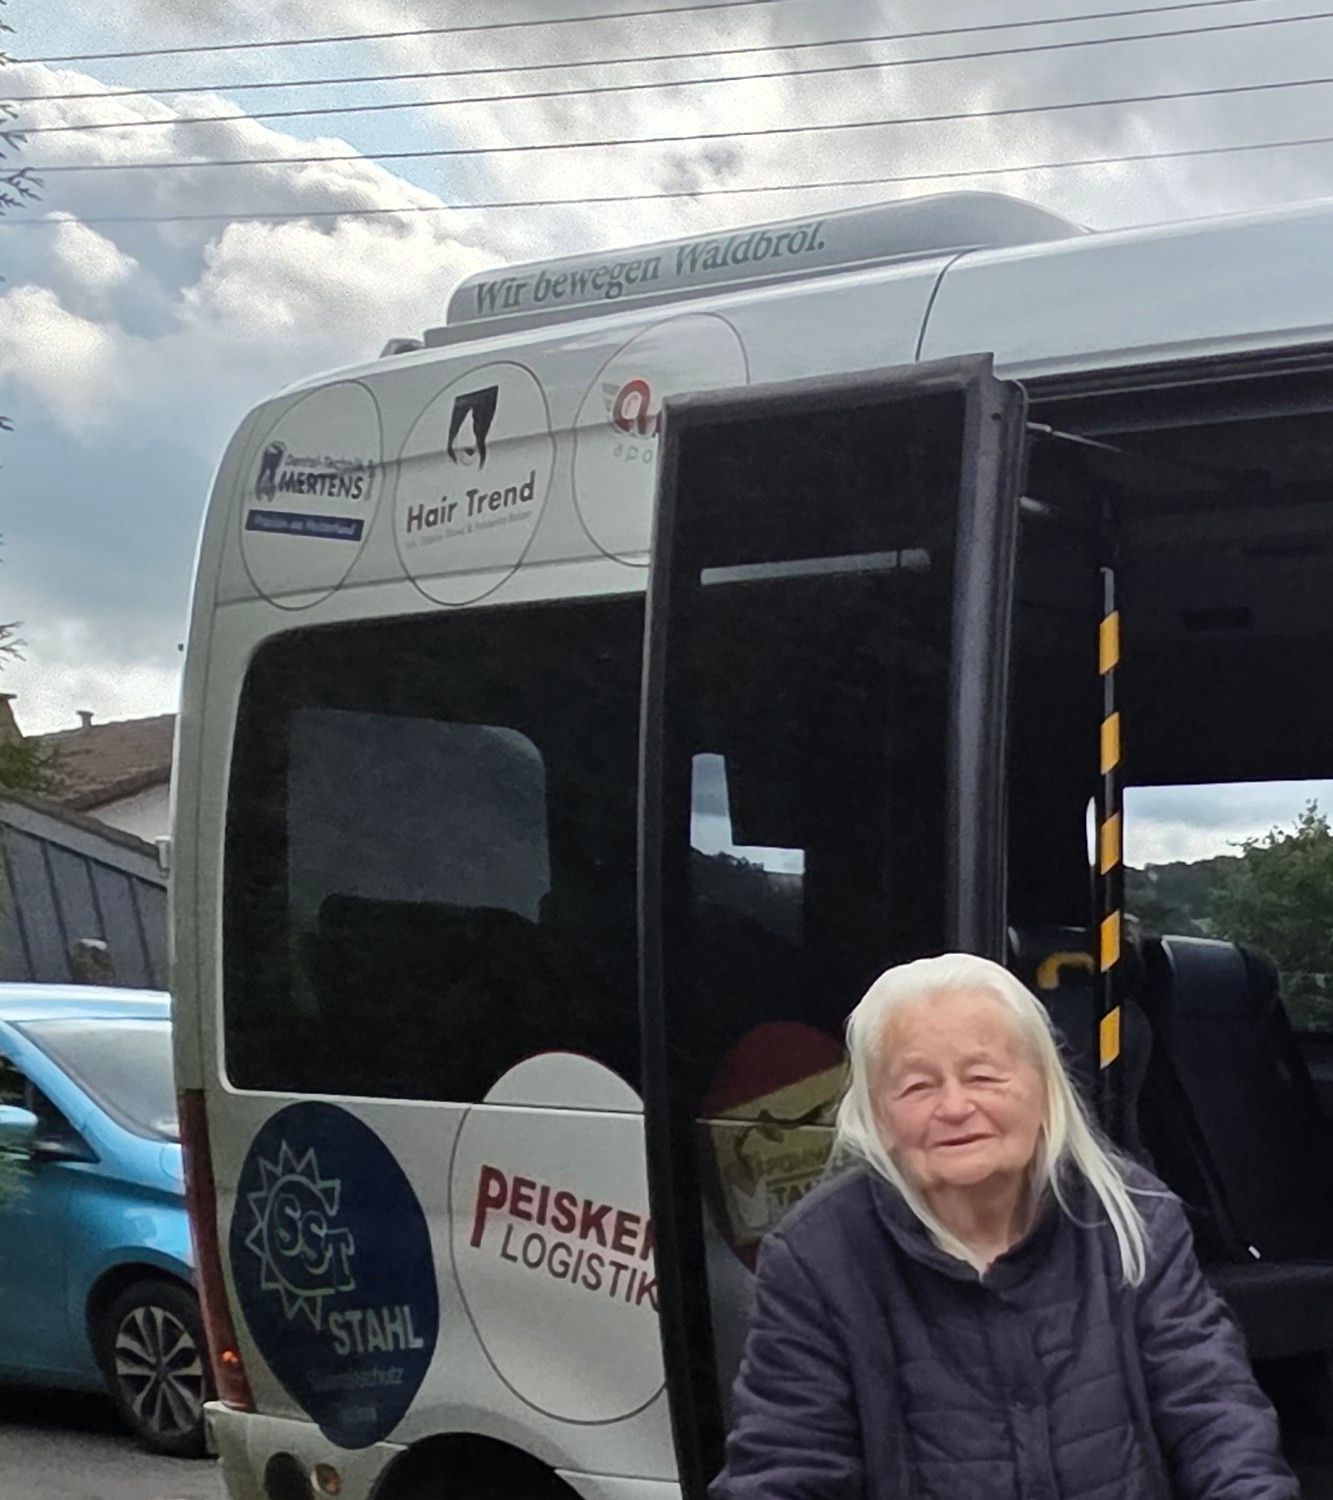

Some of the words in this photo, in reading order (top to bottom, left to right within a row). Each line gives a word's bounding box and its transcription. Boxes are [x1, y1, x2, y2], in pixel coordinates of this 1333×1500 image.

[476, 277, 526, 314] Wir
[533, 257, 661, 302] bewegen
[676, 221, 825, 276] Waldbröl.
[278, 470, 364, 500] MERTENS
[406, 495, 458, 534] Hair
[465, 469, 536, 517] Trend
[500, 1223, 660, 1313] LOGISTIK
[328, 1305, 424, 1356] STAHL
